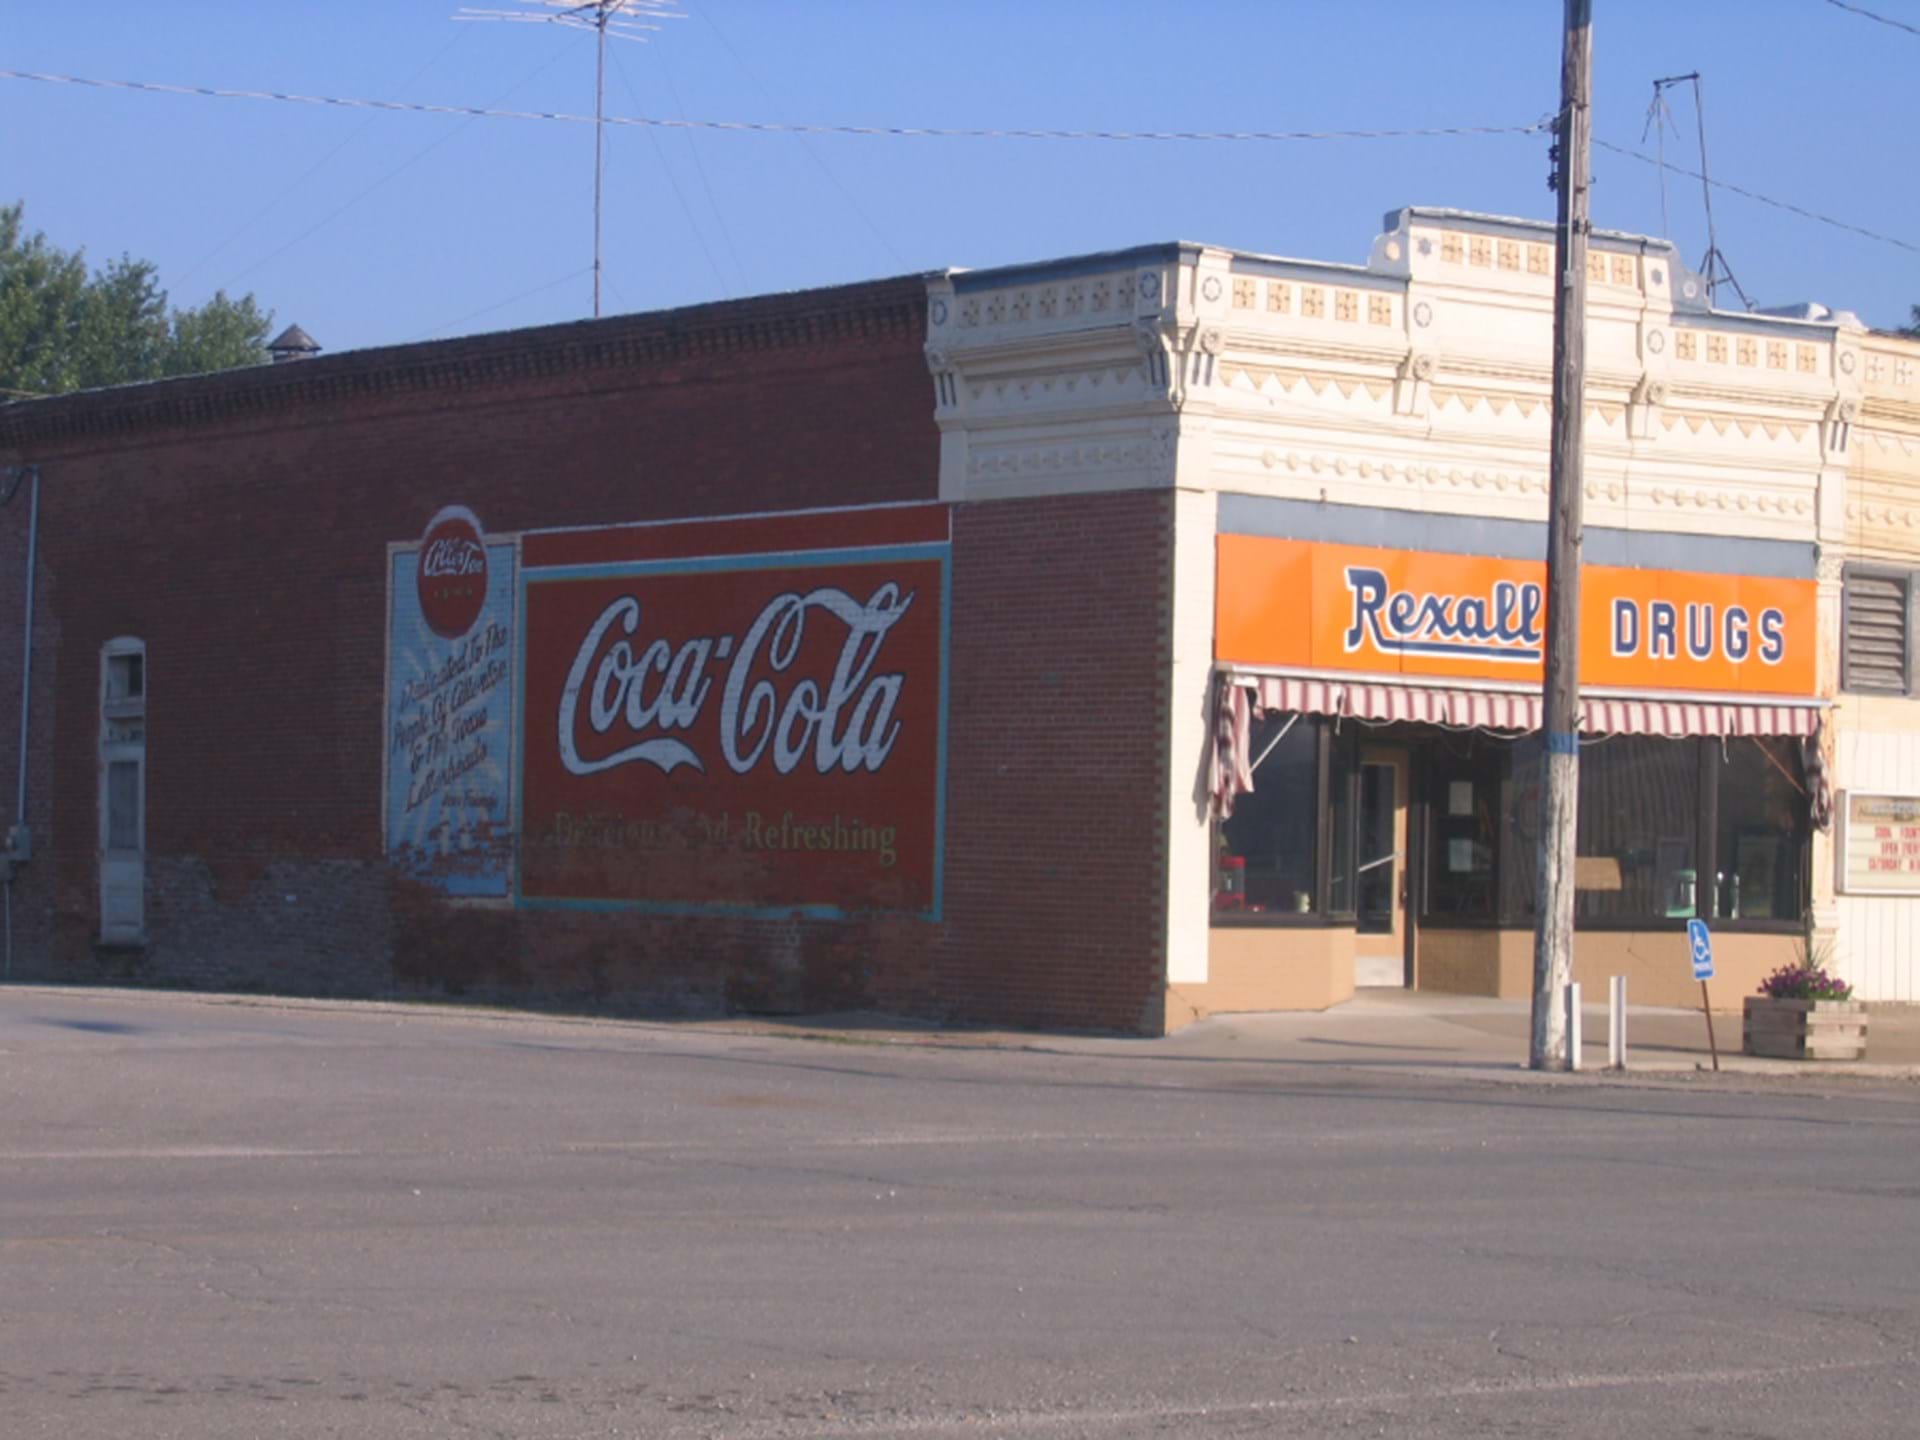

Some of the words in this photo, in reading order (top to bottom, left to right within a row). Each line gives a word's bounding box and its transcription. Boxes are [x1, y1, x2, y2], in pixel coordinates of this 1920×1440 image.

[485, 623, 507, 655] The
[1344, 567, 1542, 662] Rexall
[1612, 599, 1785, 664] DRUGS
[744, 811, 897, 866] Refreshing
